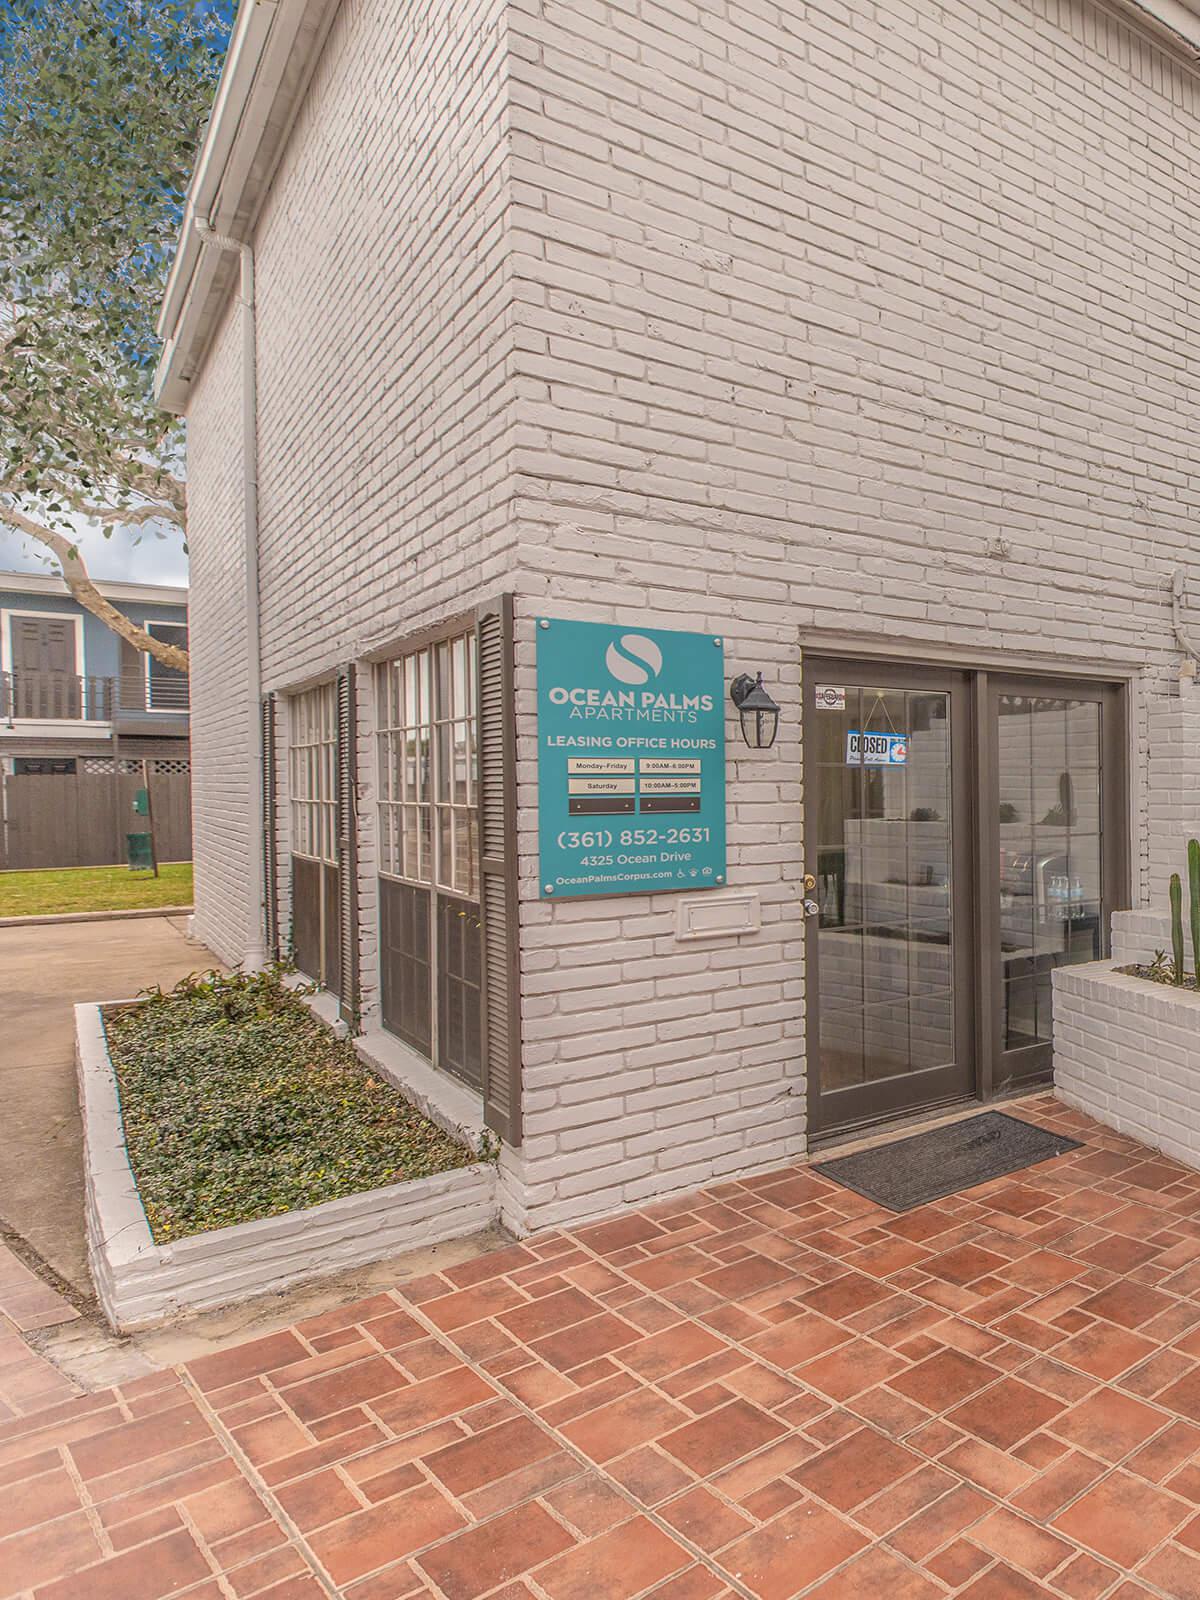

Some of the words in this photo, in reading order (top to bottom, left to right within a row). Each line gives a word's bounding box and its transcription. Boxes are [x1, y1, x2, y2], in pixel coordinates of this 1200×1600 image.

[549, 687, 635, 707] OCEAN
[641, 691, 713, 711] PALMS
[568, 706, 697, 723] APARTMENTS
[547, 735, 612, 747] LEASING
[616, 737, 667, 748] OFFICE
[671, 738, 716, 749] HOURS
[850, 736, 888, 754] CLOSED
[557, 830, 613, 849] (361)
[620, 827, 711, 846] 852-2631
[580, 855, 614, 867] 4325
[617, 853, 657, 864] Ocean
[660, 851, 692, 862] Drive
[556, 870, 673, 885] OceanPalmsCorpus.com
